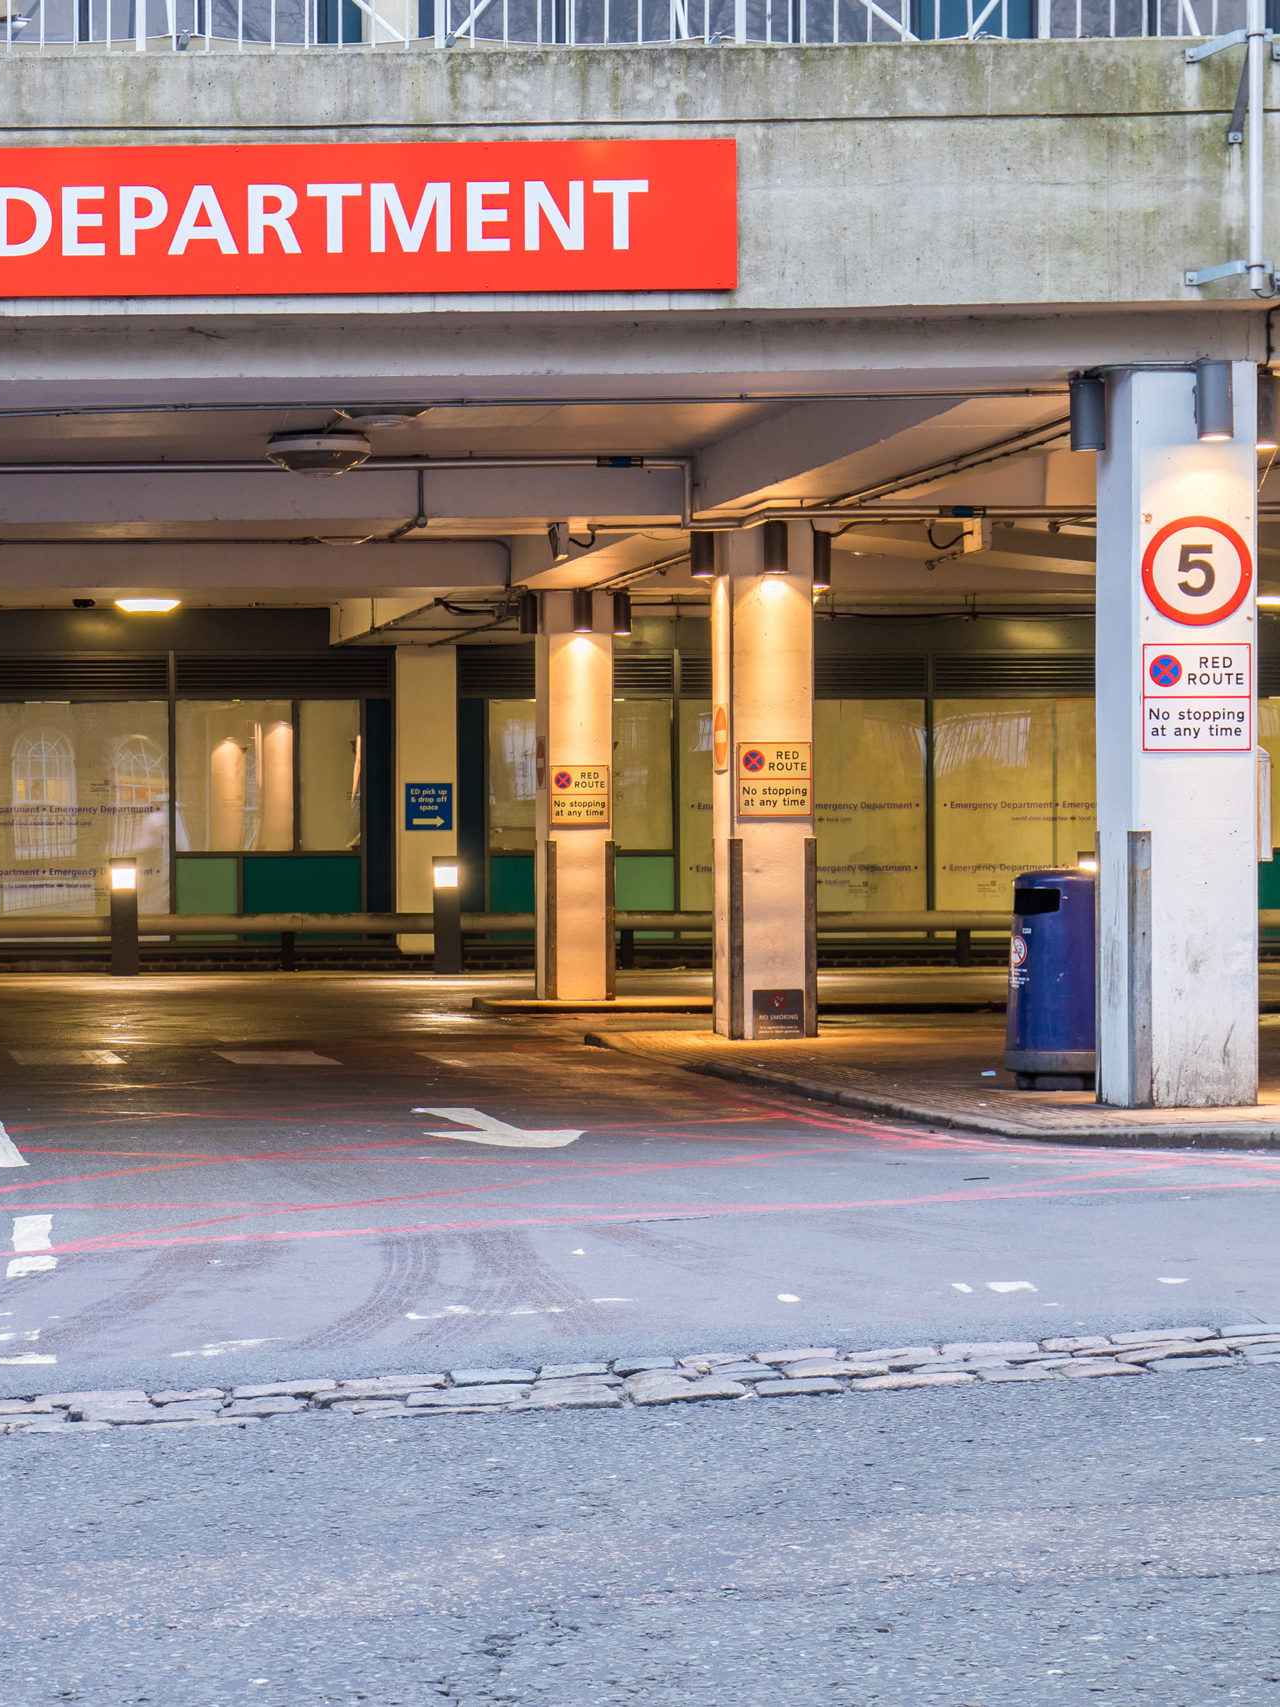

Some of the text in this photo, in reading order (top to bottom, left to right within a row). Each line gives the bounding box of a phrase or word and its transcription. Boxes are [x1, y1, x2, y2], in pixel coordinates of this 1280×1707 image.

[1177, 544, 1216, 597] 5
[1199, 656, 1233, 669] RED
[1188, 673, 1244, 685] ROUTE
[1149, 708, 1245, 722] No stopping
[1151, 724, 1242, 739] at any time
[776, 751, 799, 760] RED
[768, 762, 807, 771] ROUTE
[422, 788, 436, 796] pick
[742, 786, 808, 797] No stopping
[418, 796, 434, 804] drop
[569, 800, 606, 808] stopping
[744, 797, 805, 808] at any time
[49, 806, 98, 815] Emergency
[100, 805, 153, 814] Department
[815, 802, 913, 811] mergency Department
[950, 801, 1097, 810] Emergency Department Emerge
[49, 868, 97, 877] Emergency
[816, 864, 856, 873] mergency
[949, 864, 997, 873] Emergency
